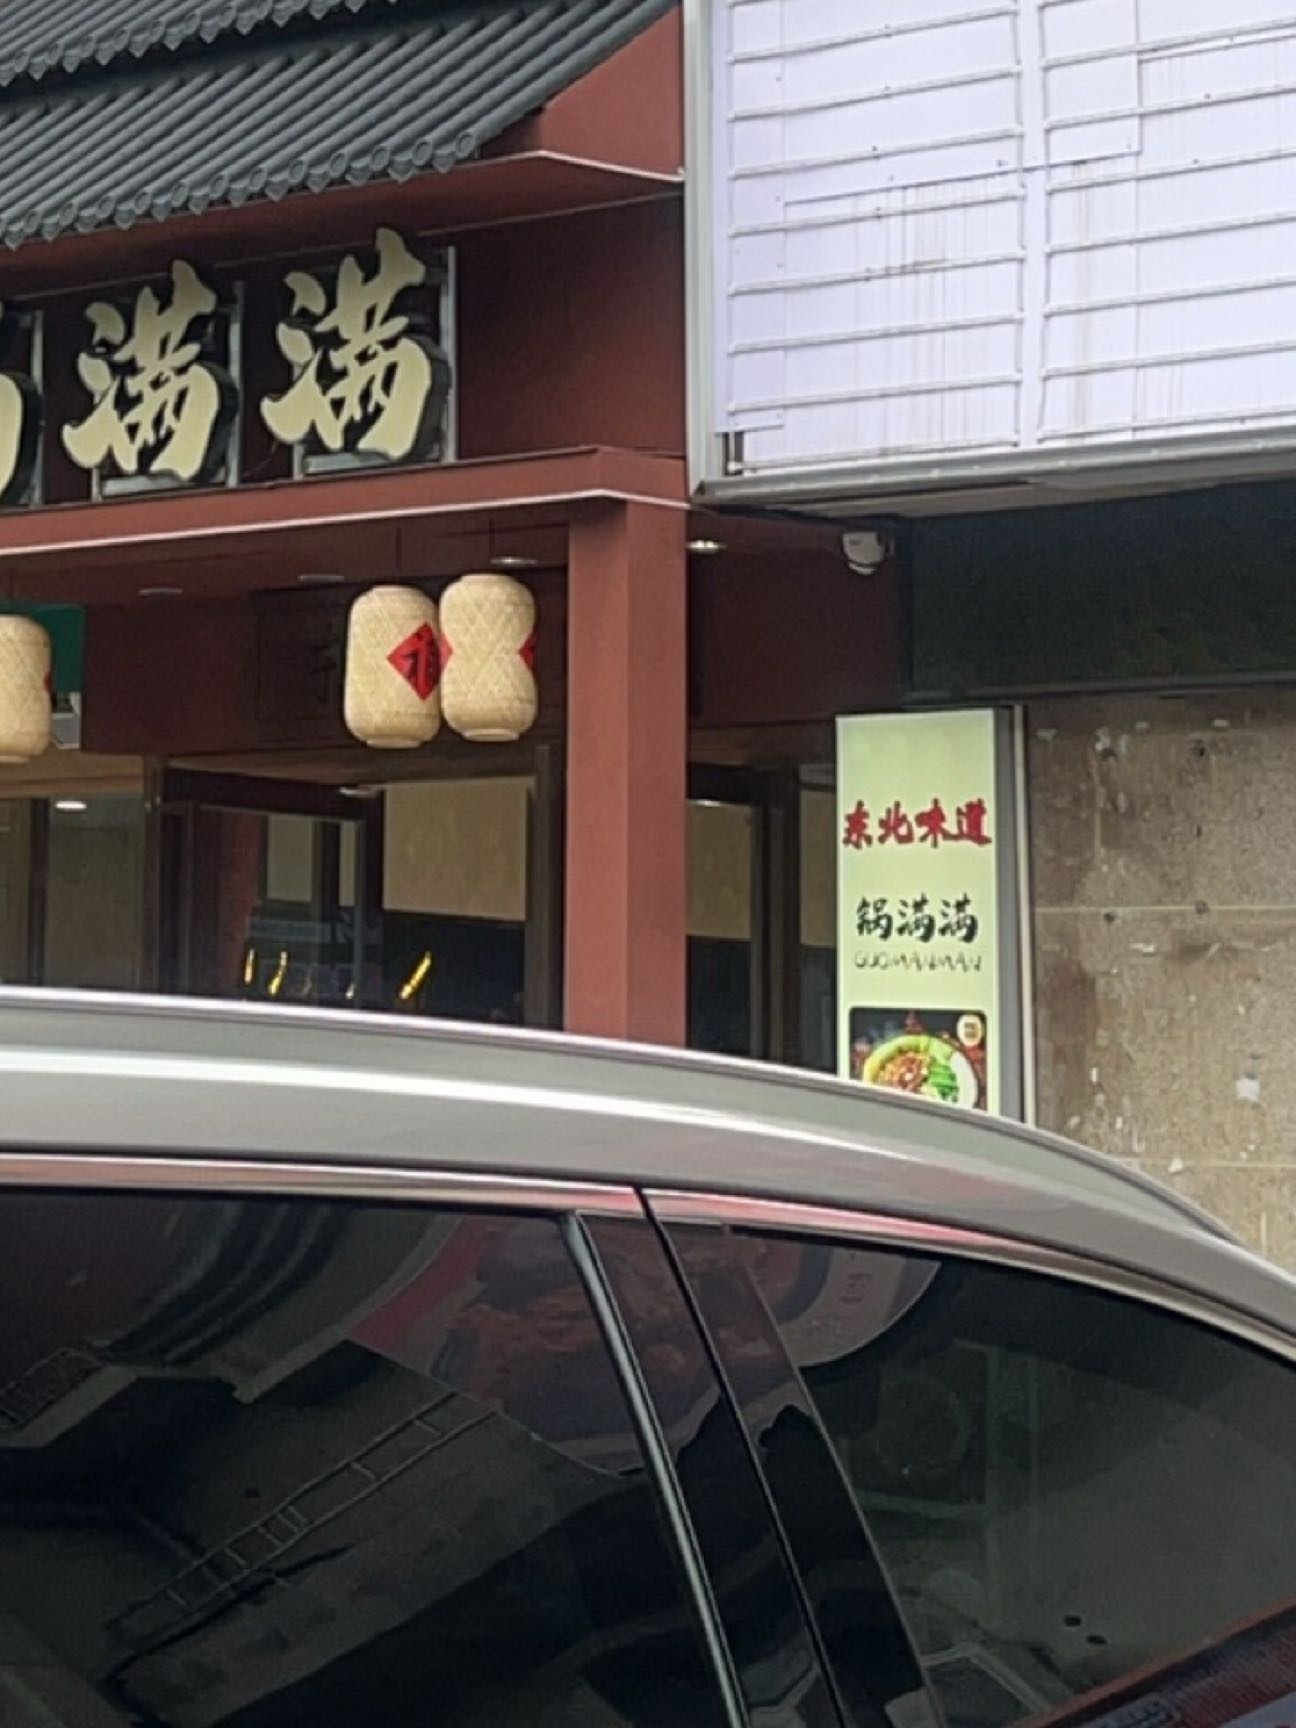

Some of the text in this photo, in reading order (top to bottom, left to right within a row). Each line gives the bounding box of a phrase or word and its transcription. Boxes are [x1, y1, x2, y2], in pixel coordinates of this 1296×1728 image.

[842, 798, 993, 850] 东北味道
[856, 892, 979, 943] 锅满满
